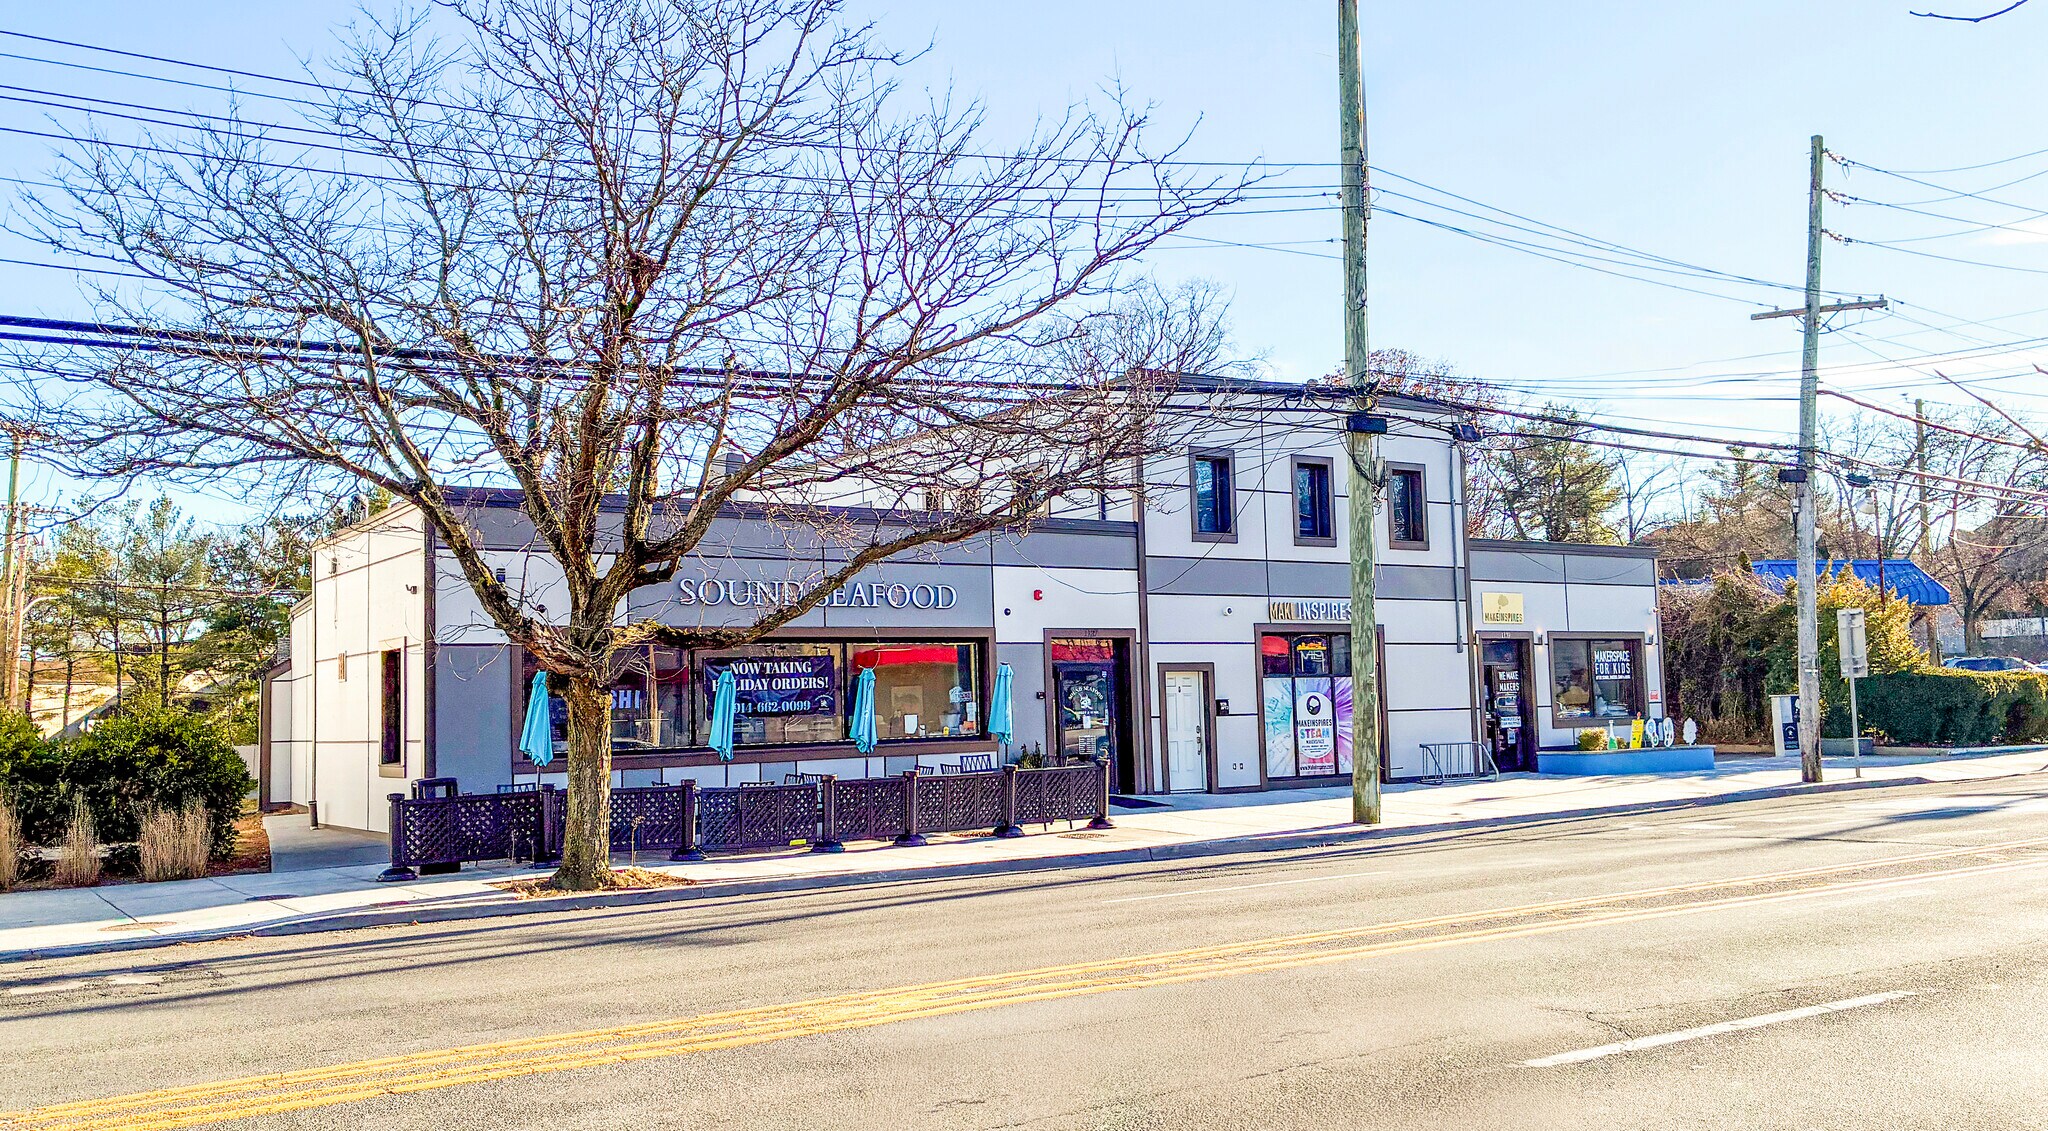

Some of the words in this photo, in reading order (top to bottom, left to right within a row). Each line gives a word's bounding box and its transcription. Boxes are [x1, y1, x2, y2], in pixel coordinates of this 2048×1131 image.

[679, 578, 800, 606] SOUND
[809, 581, 957, 610] SEAFOOD
[1484, 612, 1522, 622] MAKEINSPIRES
[1594, 650, 1631, 662] MAKERSPACE
[730, 662, 760, 675] NOW
[763, 661, 812, 674] TAKING
[1595, 662, 1610, 675] FOR
[1612, 662, 1631, 674] KIDS
[712, 679, 769, 692] HLIDAY
[771, 676, 829, 690] ORDERS!
[1499, 682, 1519, 691] MAKERS
[1300, 728, 1330, 739] STEAM
